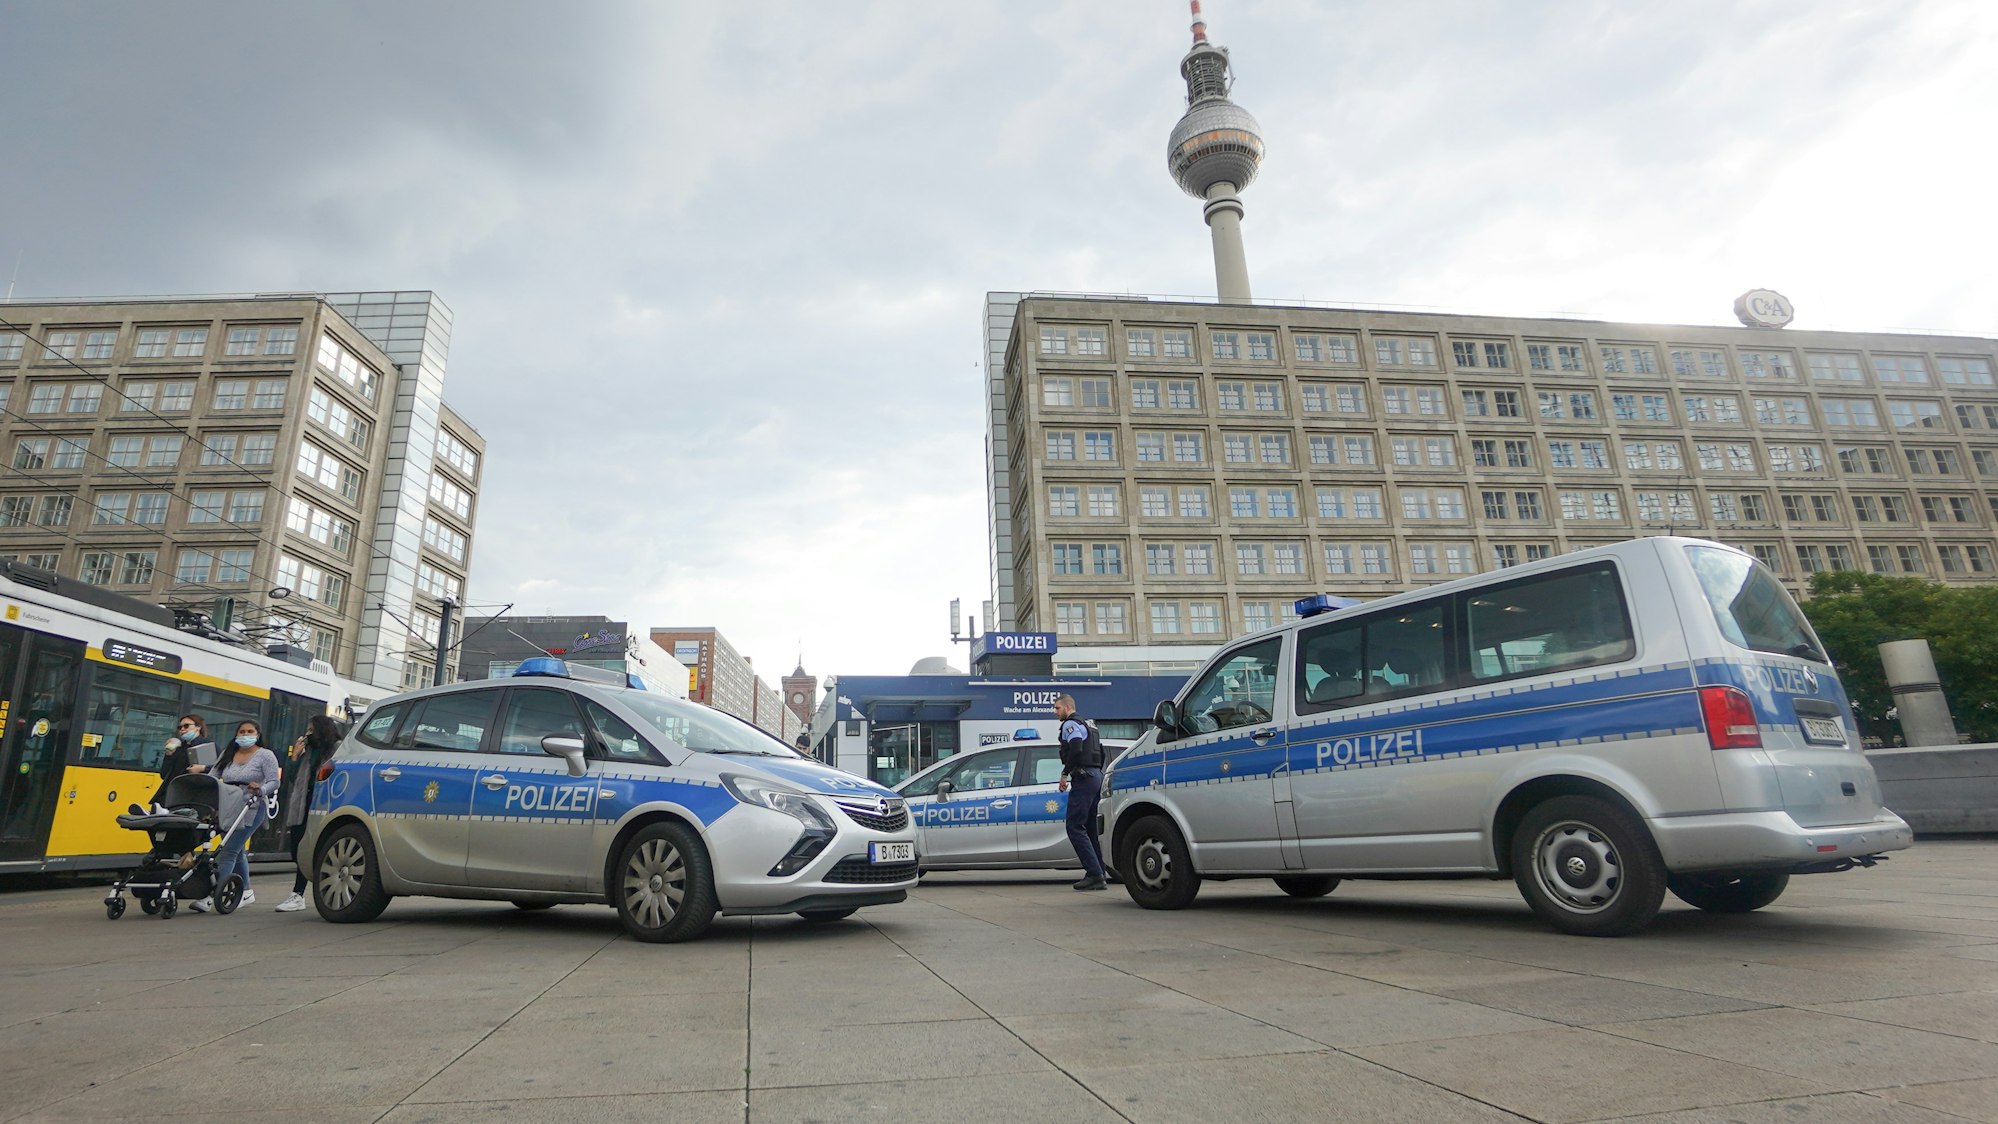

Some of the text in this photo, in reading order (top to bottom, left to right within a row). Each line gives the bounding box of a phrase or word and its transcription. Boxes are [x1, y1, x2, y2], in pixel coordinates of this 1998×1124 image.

[1751, 297, 1789, 317] C&A
[996, 636, 1047, 649] POLIZEI
[1741, 665, 1809, 694] POLIZEI
[981, 734, 1008, 744] POLIZEI
[1316, 729, 1424, 767] POLIZEI
[505, 785, 595, 812] POLIZEI
[927, 806, 989, 822] POLIZEI
